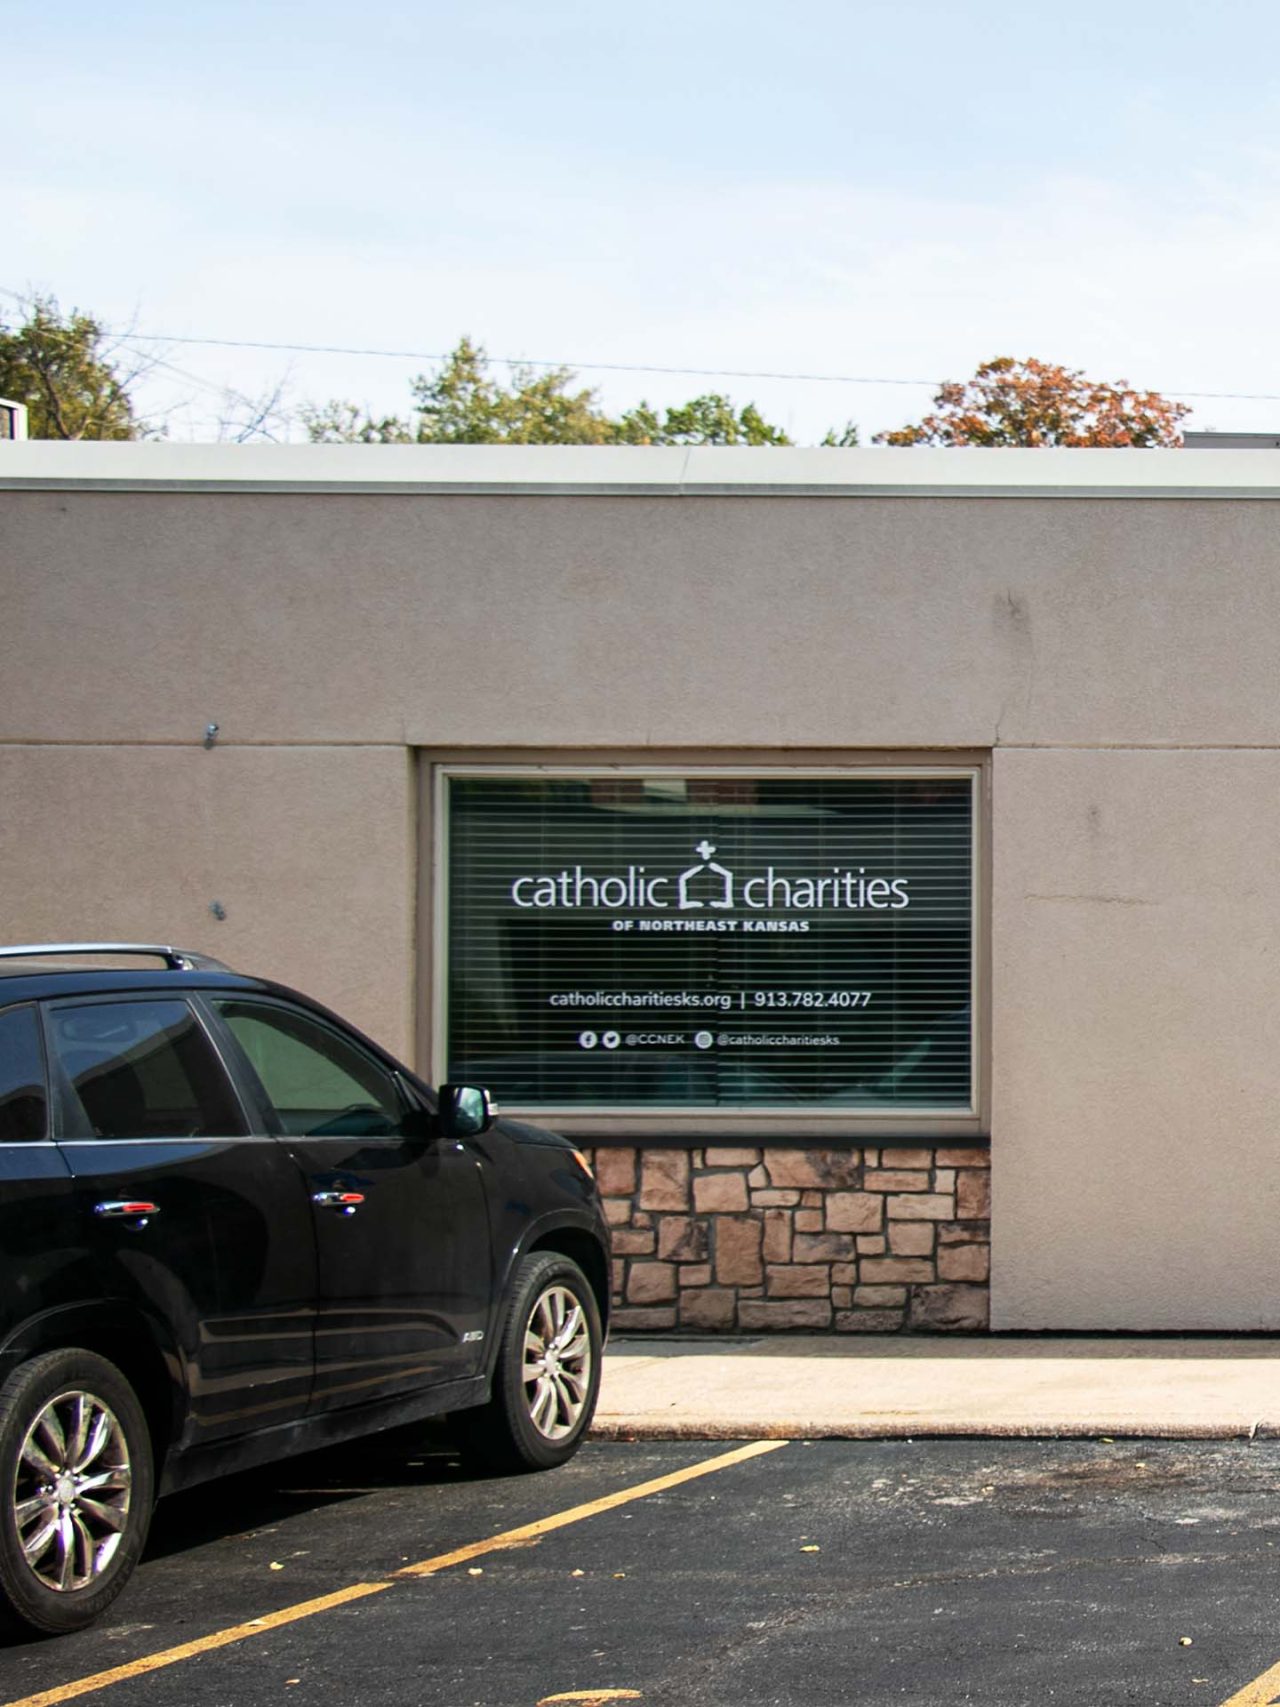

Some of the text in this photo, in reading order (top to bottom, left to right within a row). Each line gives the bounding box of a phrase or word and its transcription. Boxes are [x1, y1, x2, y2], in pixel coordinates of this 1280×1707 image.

[512, 866, 910, 909] catholic charities
[613, 920, 810, 932] OF NORTHEAST KANSAS
[549, 991, 732, 1009] catholiccharitiesks.org
[754, 991, 872, 1007] 913.782.4077
[625, 1033, 840, 1047] @CCNEK @catholiccharitiesks
